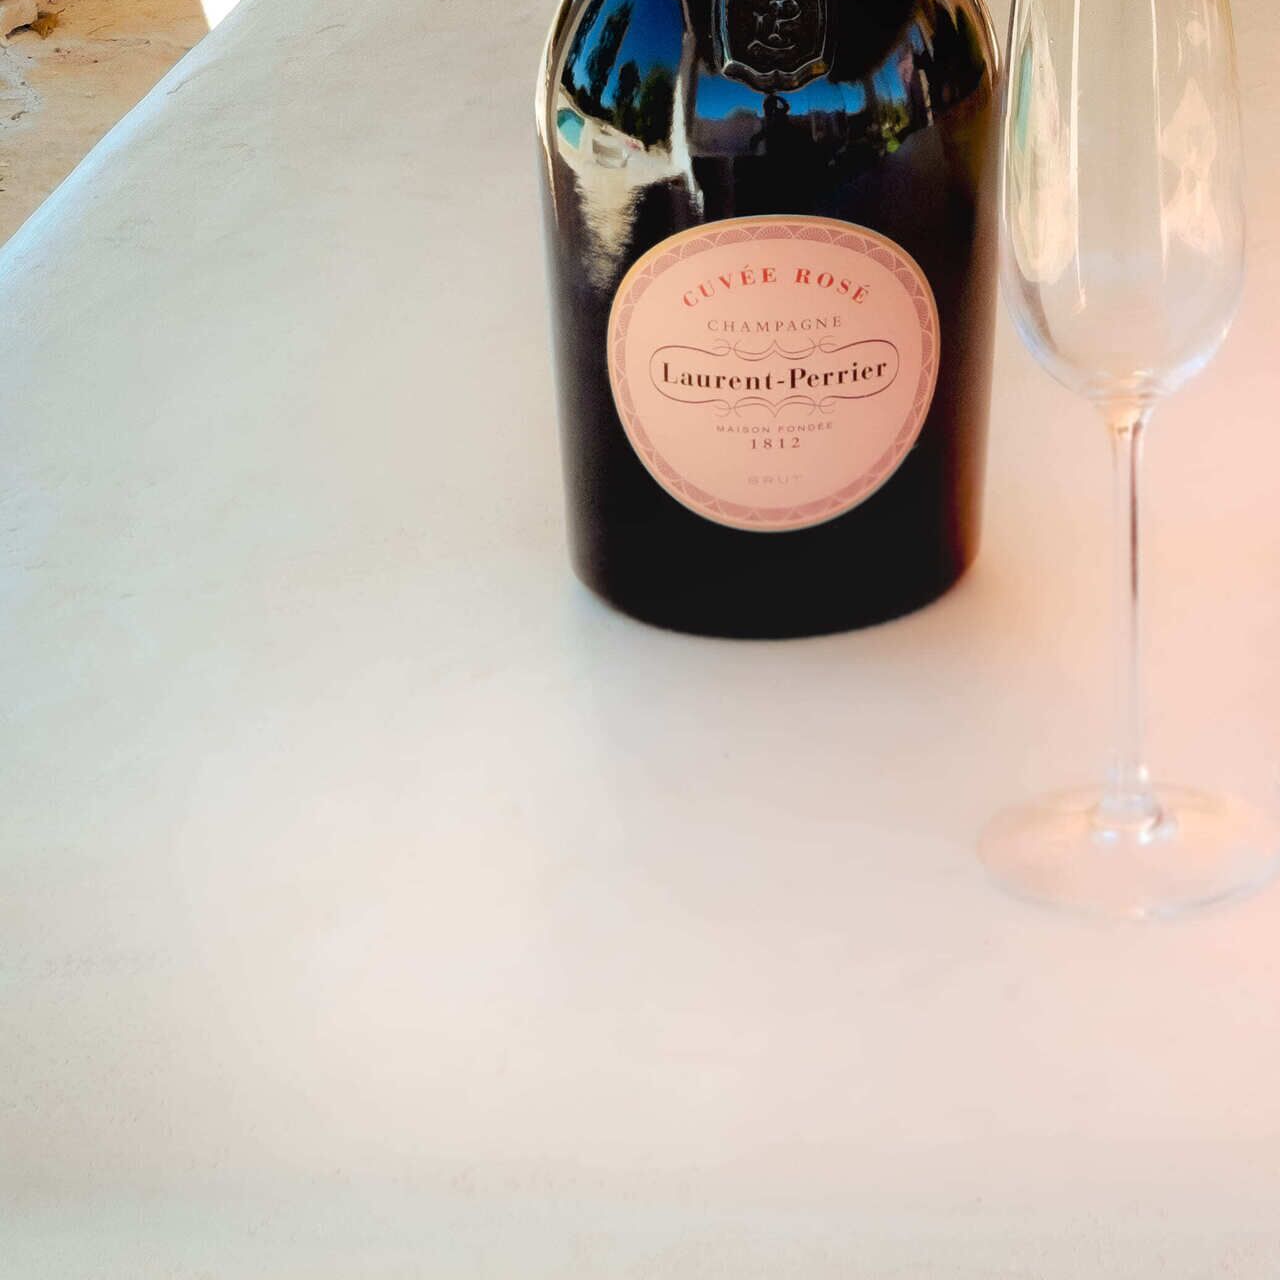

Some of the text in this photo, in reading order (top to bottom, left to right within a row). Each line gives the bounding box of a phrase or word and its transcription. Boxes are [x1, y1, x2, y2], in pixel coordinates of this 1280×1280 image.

[682, 263, 872, 308] CUVÉE ROSÉ
[707, 315, 842, 333] CHAMPAGNE
[662, 361, 888, 391] Laurent-Perrier
[716, 421, 833, 434] MAISON FONDÉE
[751, 436, 801, 450] 1812
